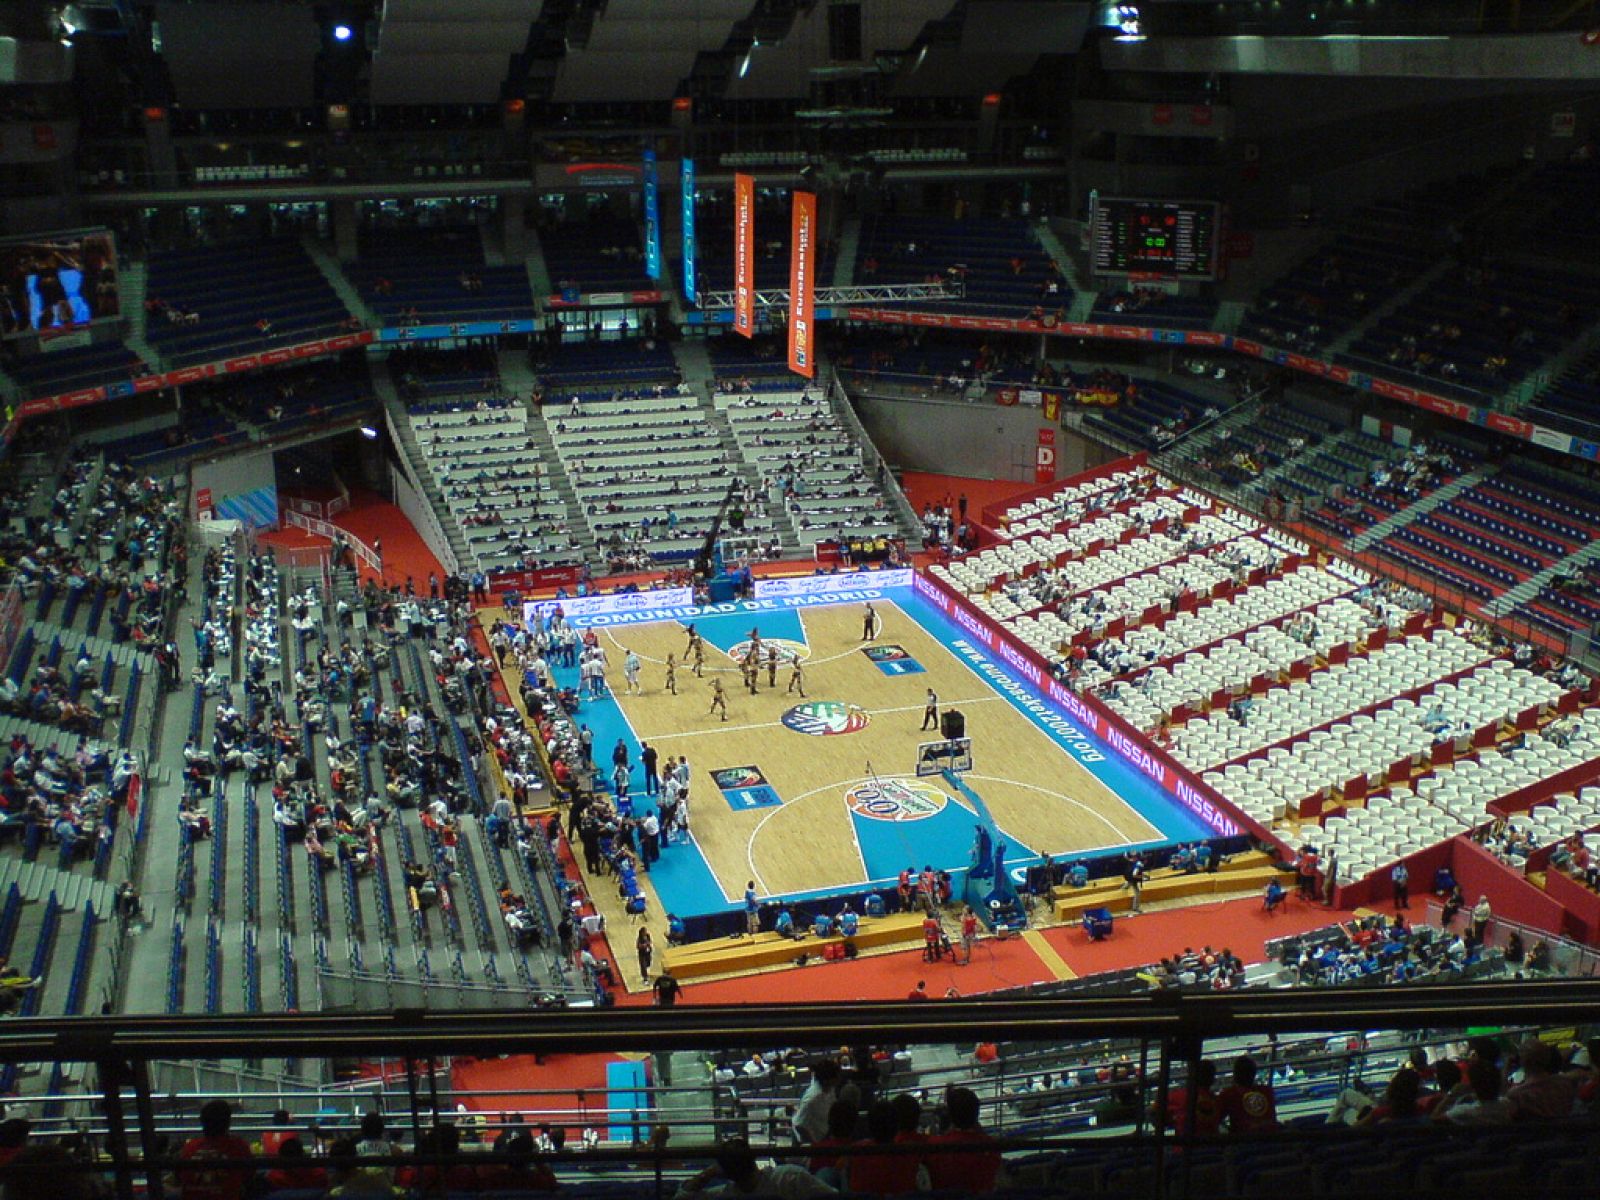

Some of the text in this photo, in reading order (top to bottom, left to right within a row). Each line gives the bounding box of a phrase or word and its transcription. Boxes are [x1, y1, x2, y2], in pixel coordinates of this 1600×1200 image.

[1038, 447, 1053, 465] D
[574, 604, 736, 626] COMUNIDAD
[743, 599, 777, 611] DE
[783, 590, 881, 606] MADRID
[915, 574, 948, 610] NISSAN
[954, 605, 992, 645] NISSAN
[1000, 640, 1041, 685] NISSAN
[951, 639, 1106, 762] www.eurobasket2007.org
[1049, 680, 1098, 730] NISSAN
[1107, 727, 1165, 782] NISSAN
[1176, 780, 1239, 836] NISSAN
